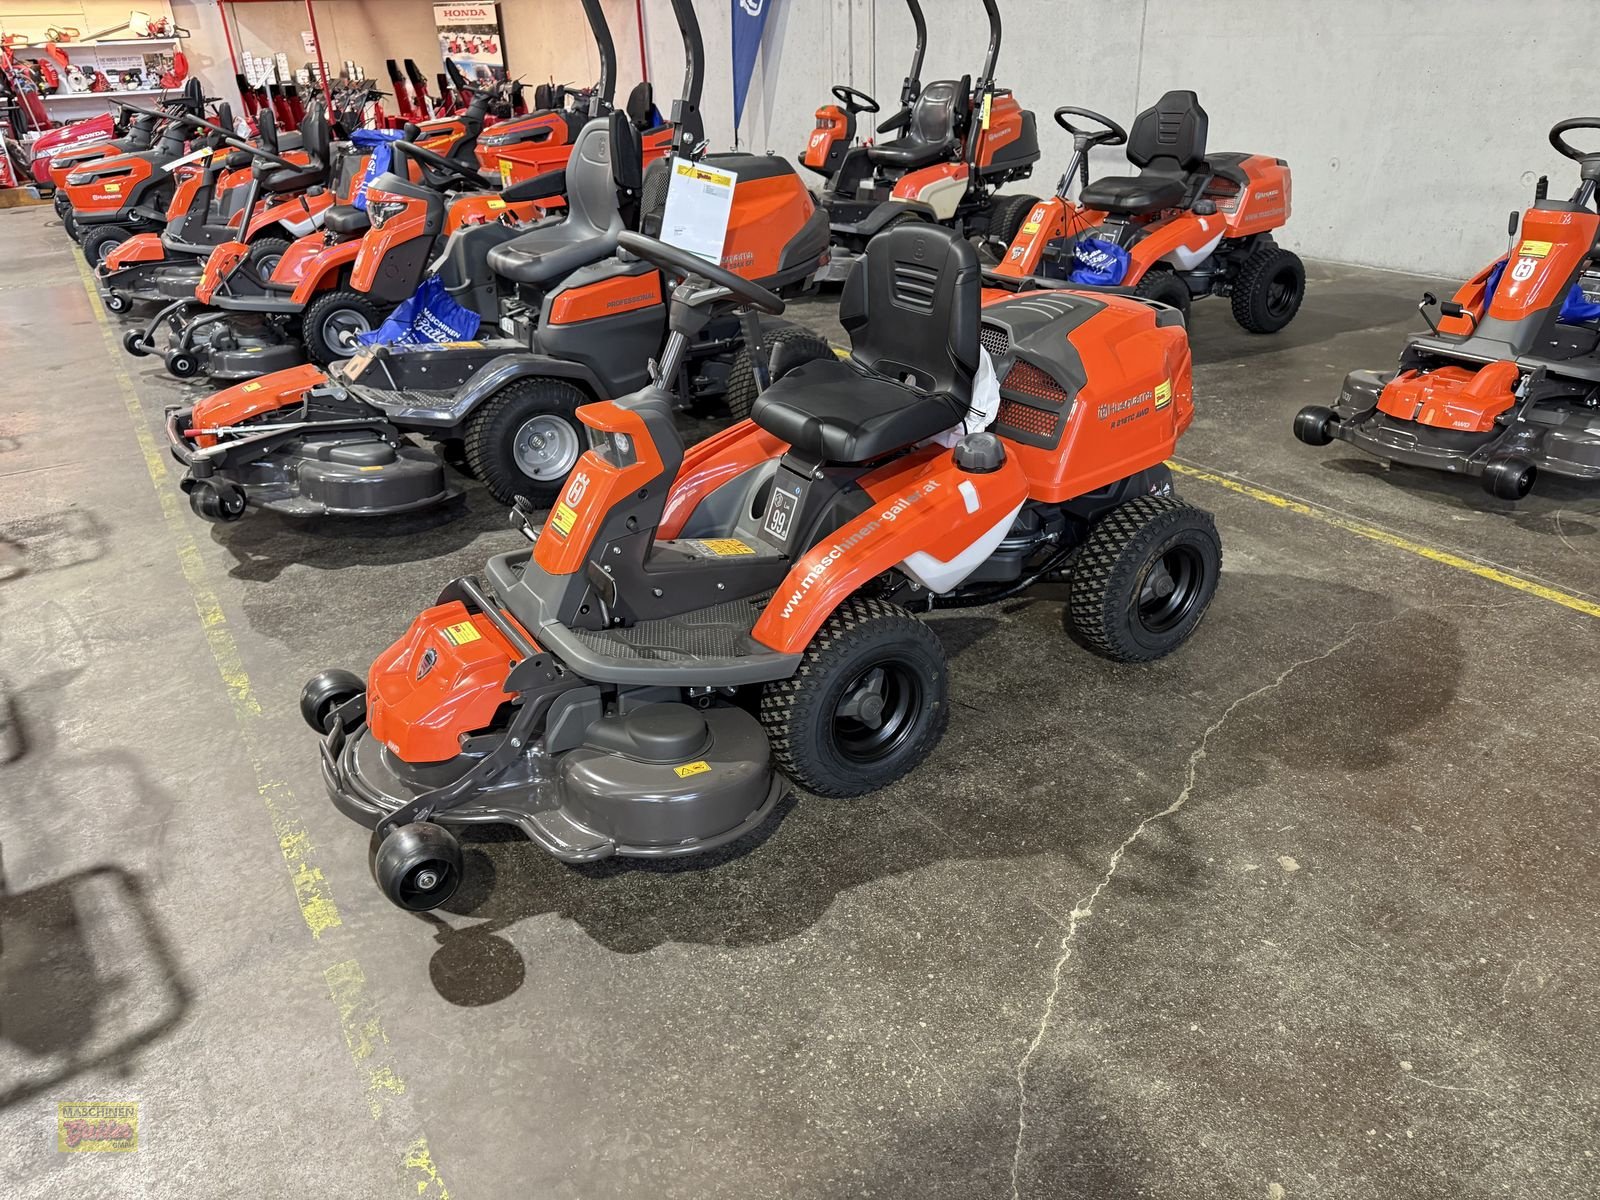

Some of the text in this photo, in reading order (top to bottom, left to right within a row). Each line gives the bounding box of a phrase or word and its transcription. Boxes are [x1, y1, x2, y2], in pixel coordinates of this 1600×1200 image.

[443, 9, 487, 17] HONDA
[77, 130, 107, 140] HONDA
[422, 307, 461, 339] MASCHINEN
[771, 510, 786, 534] 99
[780, 479, 941, 620] www.maschinen-gailer.at
